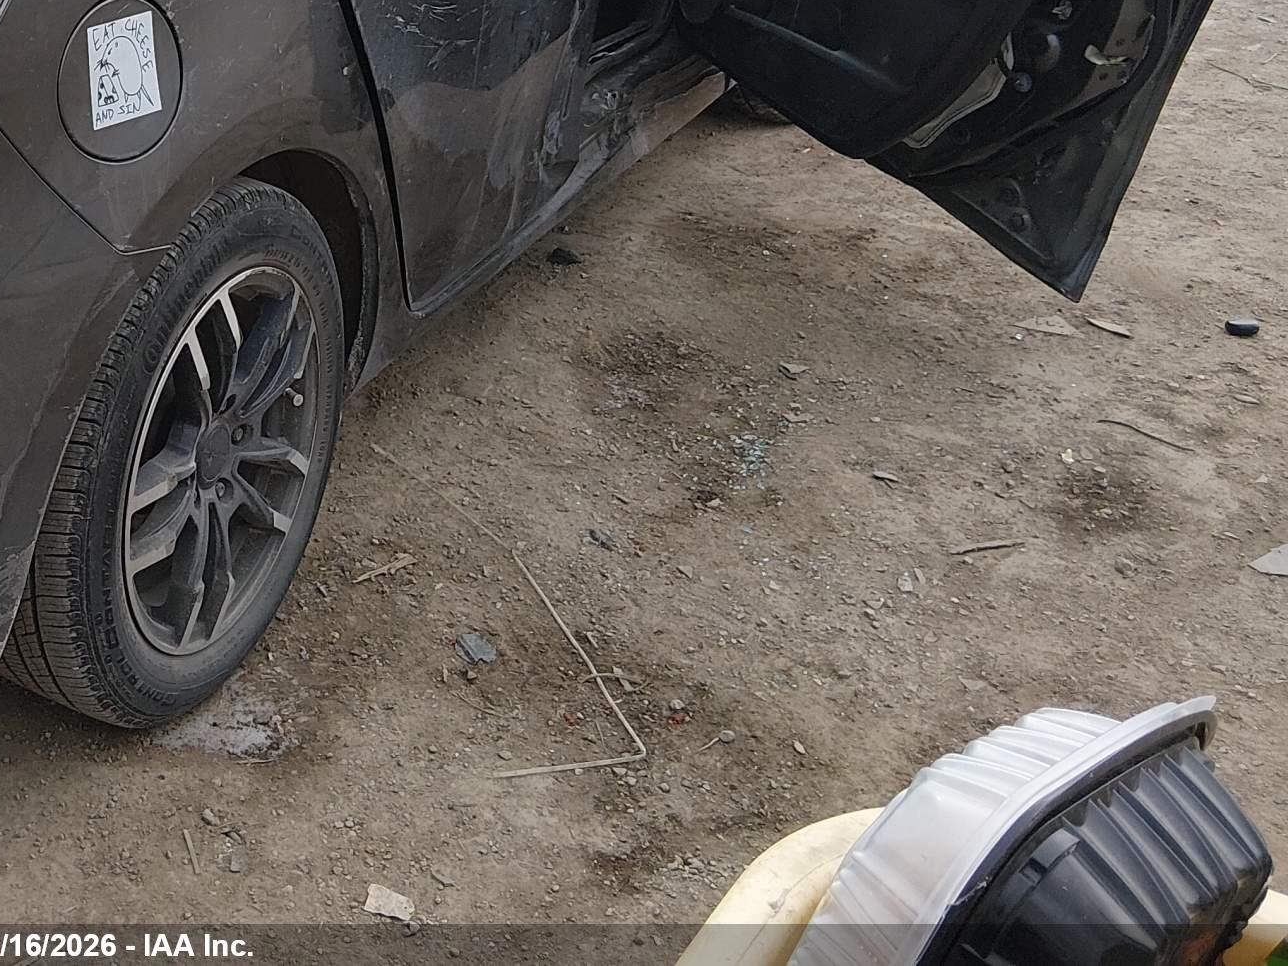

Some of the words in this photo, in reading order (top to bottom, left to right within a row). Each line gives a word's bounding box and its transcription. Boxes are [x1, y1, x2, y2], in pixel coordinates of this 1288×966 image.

[92, 22, 116, 52] EAT
[124, 19, 154, 73] CHEESE
[95, 109, 115, 128] AND
[117, 103, 142, 116] SIN
